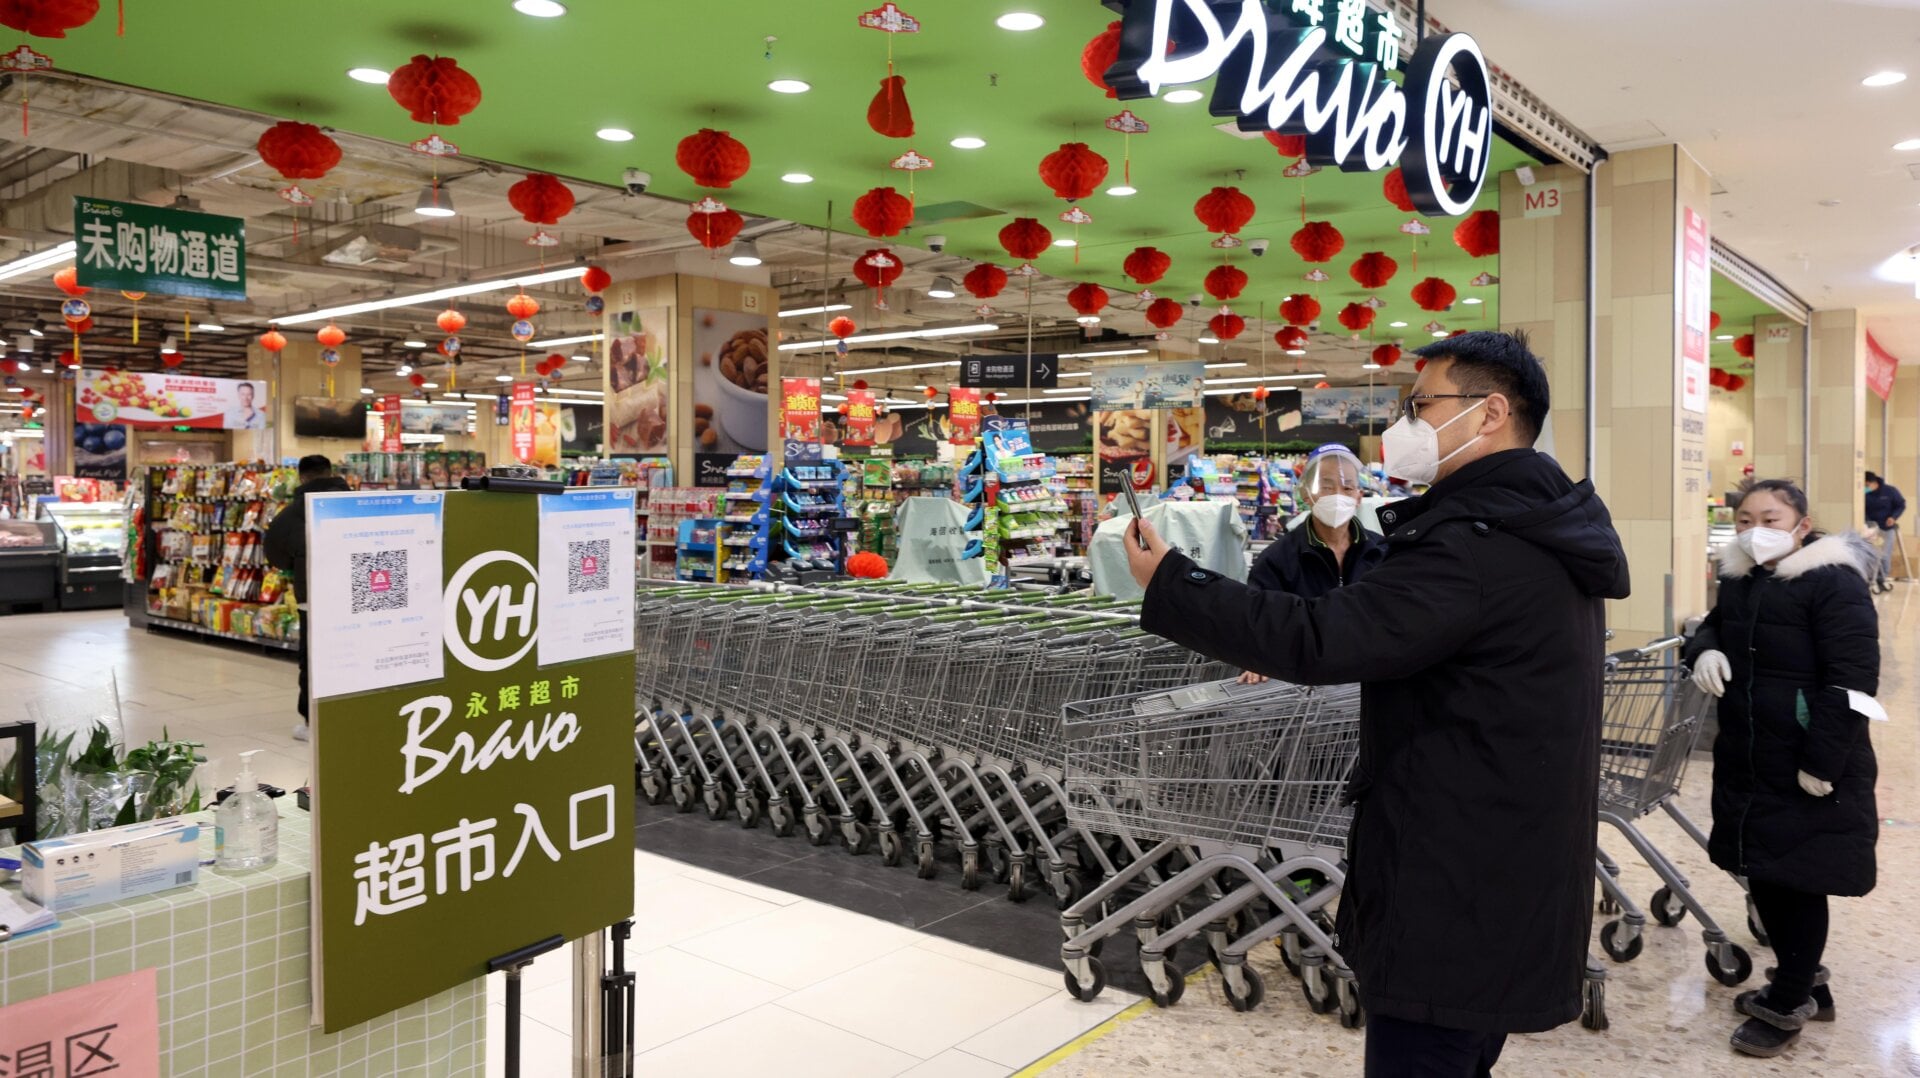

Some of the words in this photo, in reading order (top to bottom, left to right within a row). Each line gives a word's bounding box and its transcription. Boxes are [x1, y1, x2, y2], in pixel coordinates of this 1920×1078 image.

[1526, 188, 1559, 210] M3
[82, 218, 240, 282] 未购物通道
[744, 296, 757, 308] L3
[461, 582, 536, 644] YH
[465, 675, 581, 719] 永辉超市
[398, 694, 582, 794] Bravo
[353, 783, 616, 926] 超市入口
